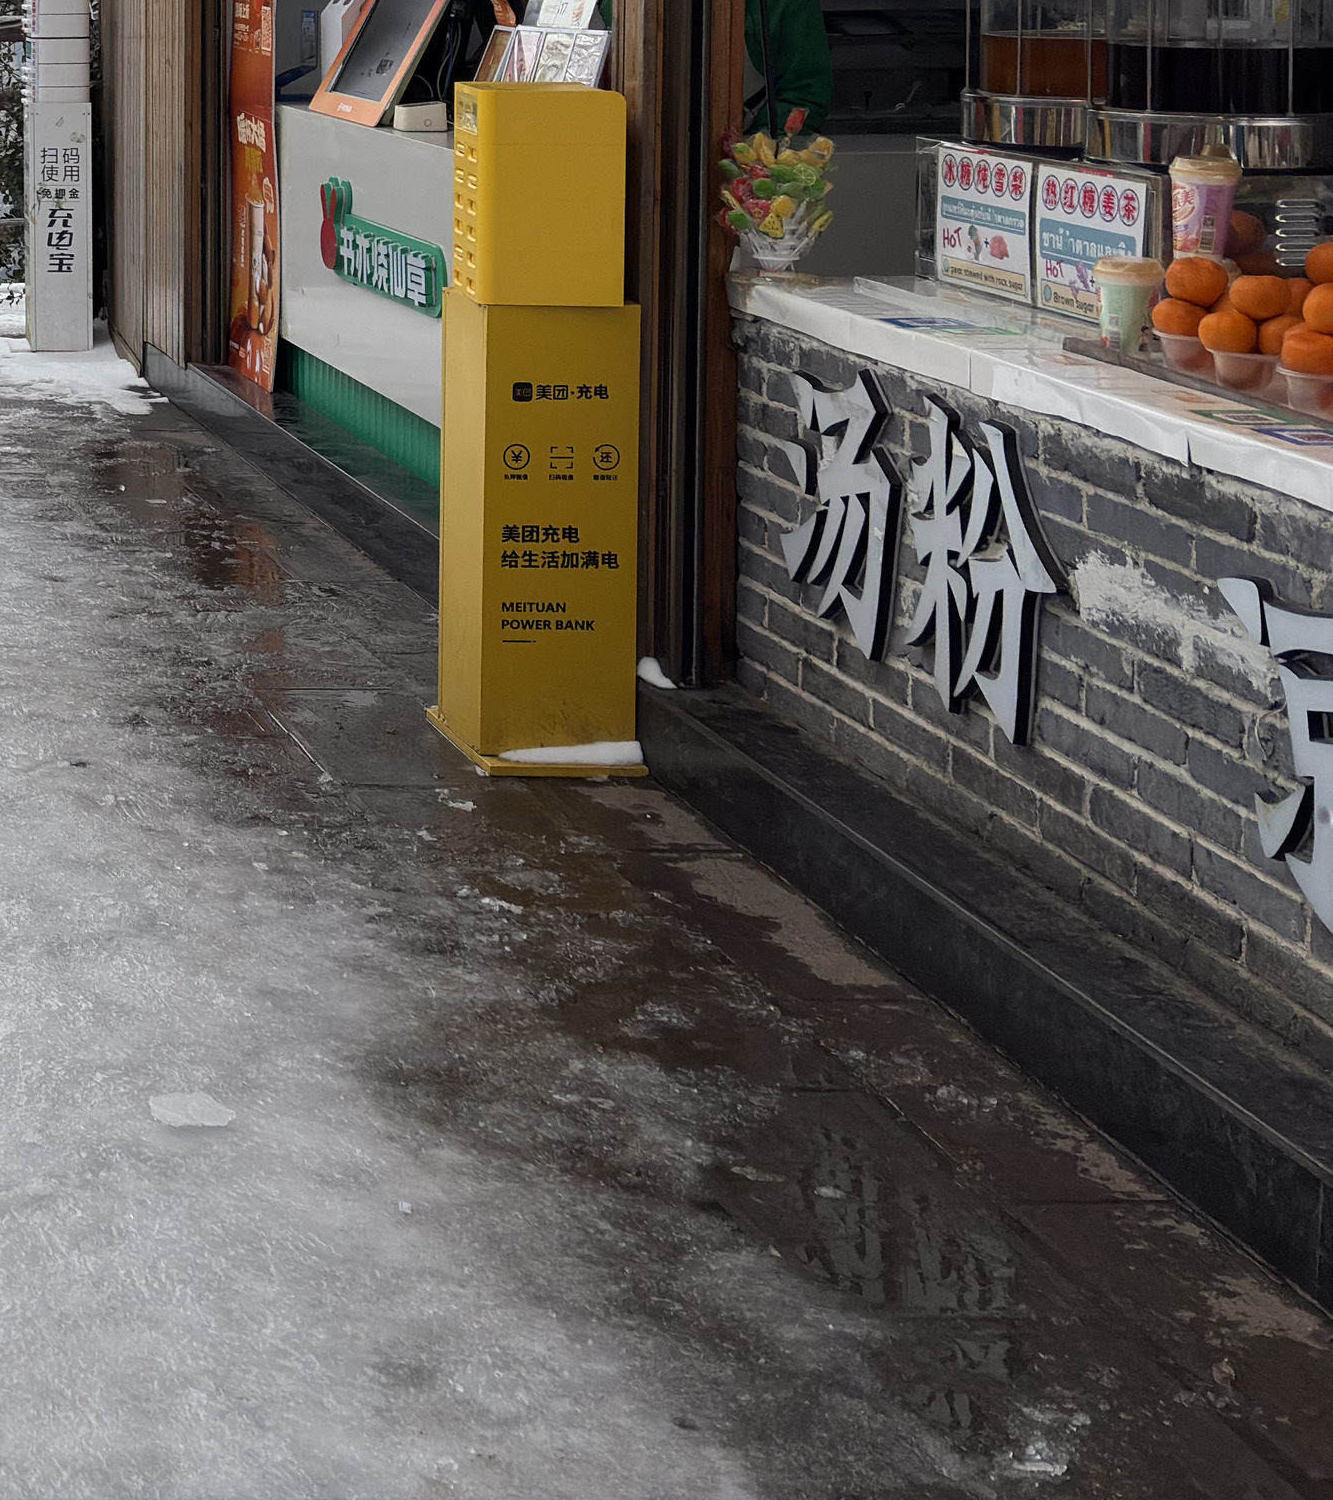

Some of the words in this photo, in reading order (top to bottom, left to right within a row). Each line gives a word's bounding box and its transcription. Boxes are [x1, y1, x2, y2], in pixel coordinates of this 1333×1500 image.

[41, 147, 80, 164] 扫码
[41, 165, 80, 182] 使用
[944, 157, 1024, 197] 冰糖炖雪梨
[1044, 178, 1136, 221] 热红糖姜茶
[47, 207, 75, 273] 充电宝
[340, 225, 427, 307] 书亦烧仙草
[501, 525, 580, 543] 美团充电
[501, 550, 620, 569] 给生活加满电
[781, 368, 1061, 745] 汤粉
[501, 602, 567, 613] MEITUAN
[501, 619, 552, 630] POWER
[555, 620, 595, 631] BANK
